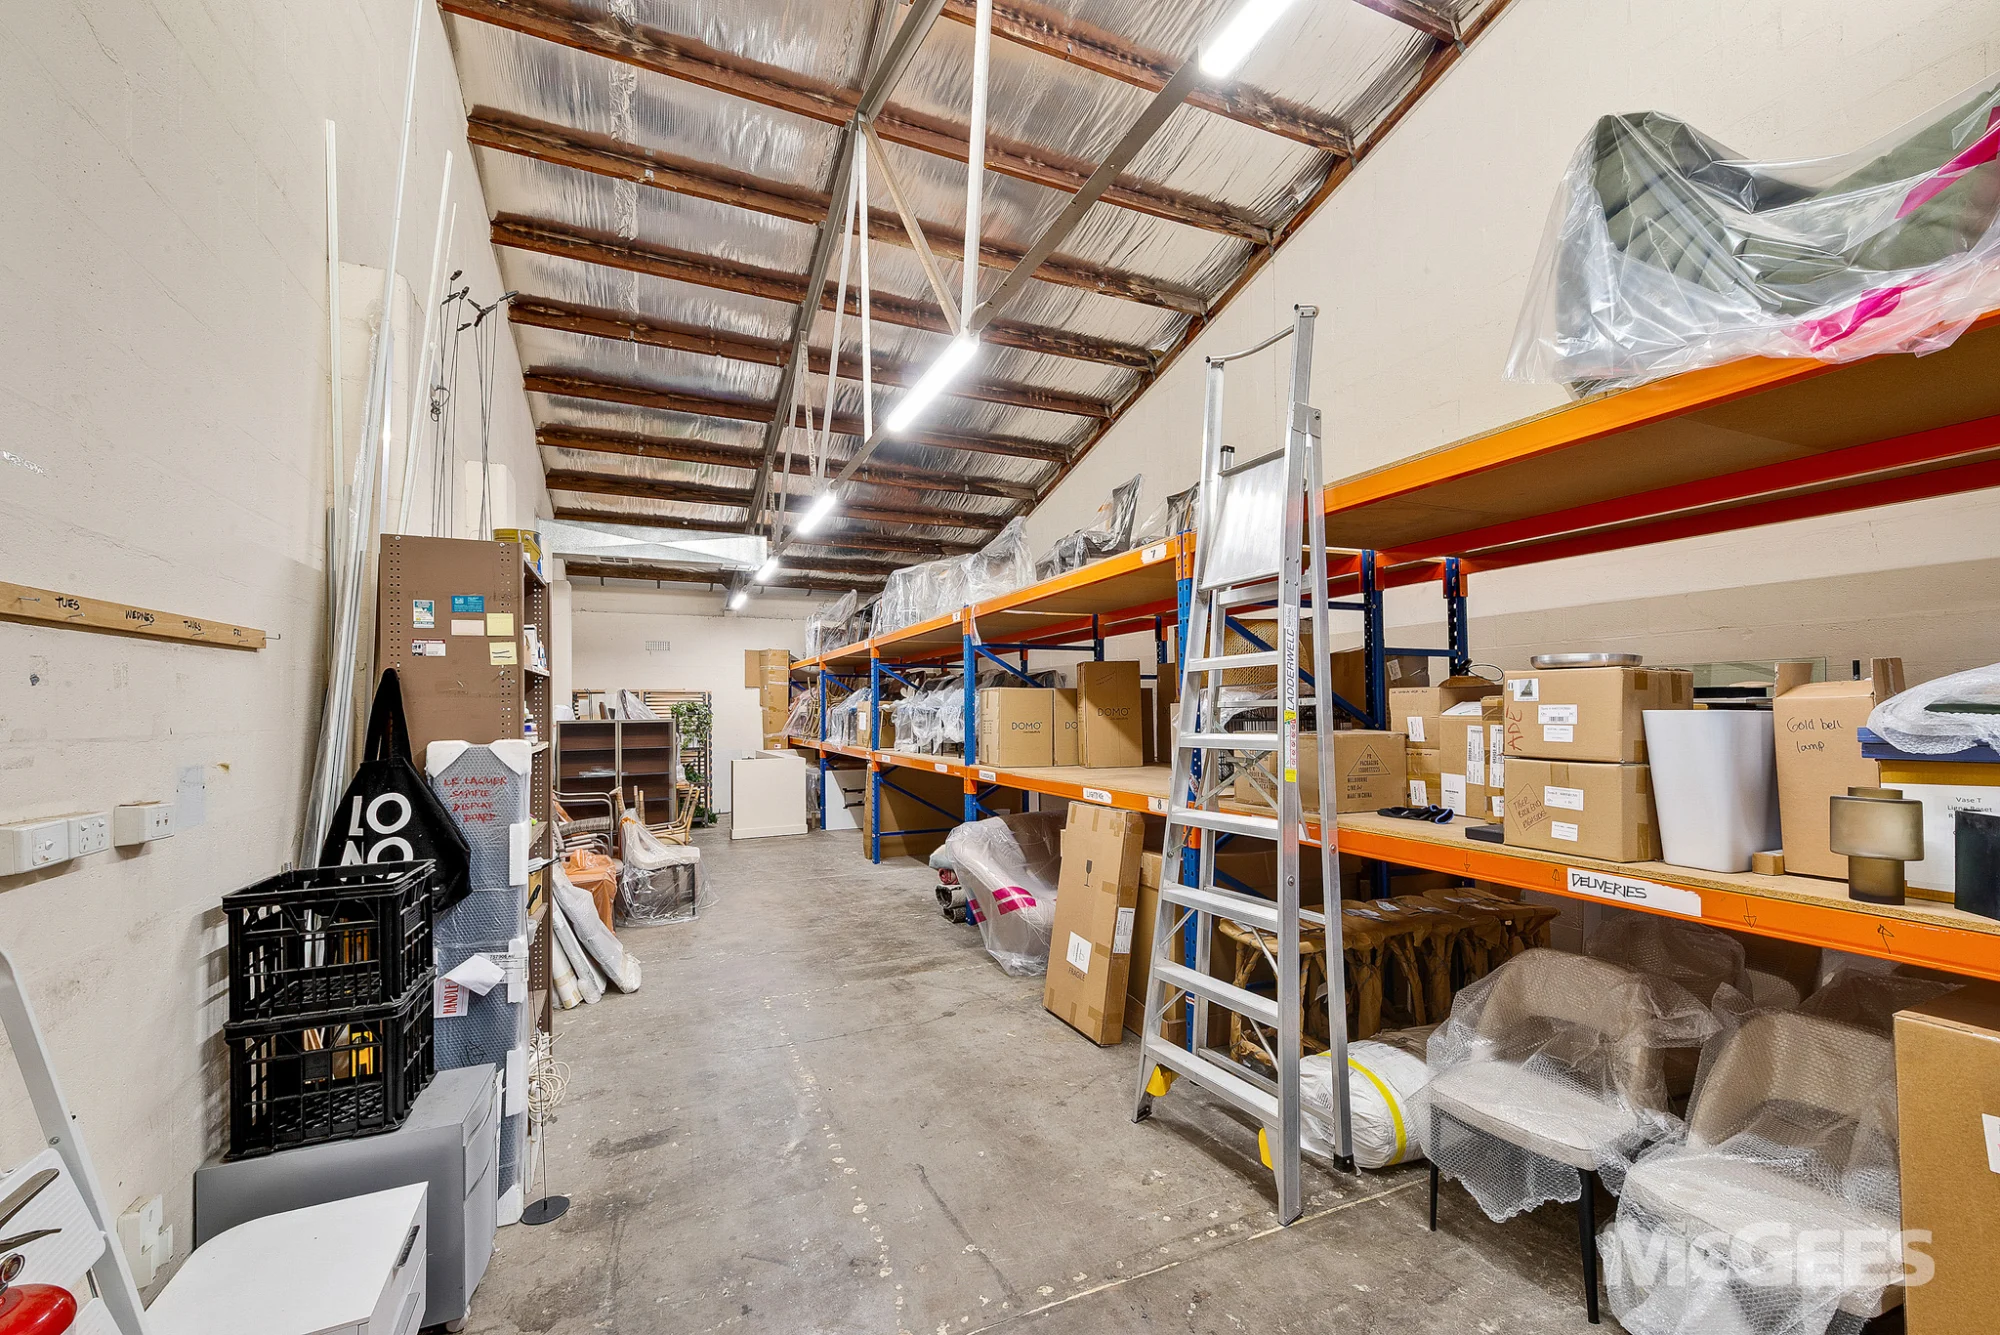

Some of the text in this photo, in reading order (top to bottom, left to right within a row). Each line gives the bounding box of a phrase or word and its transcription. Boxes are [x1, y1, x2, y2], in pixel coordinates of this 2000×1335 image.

[54, 596, 81, 611] TUES
[125, 609, 155, 624] WEDNES
[183, 620, 202, 632] THURS
[233, 628, 242, 637] FRI
[1097, 707, 1130, 717] DOMO
[1011, 721, 1042, 731] DOMO
[1786, 716, 1843, 733] Gold bell
[1796, 740, 1825, 754] lamp
[1157, 799, 1162, 810] 8
[463, 813, 496, 823] BOARD
[1571, 873, 1647, 899] DELIVERIES
[443, 984, 459, 1014] HANDLE
